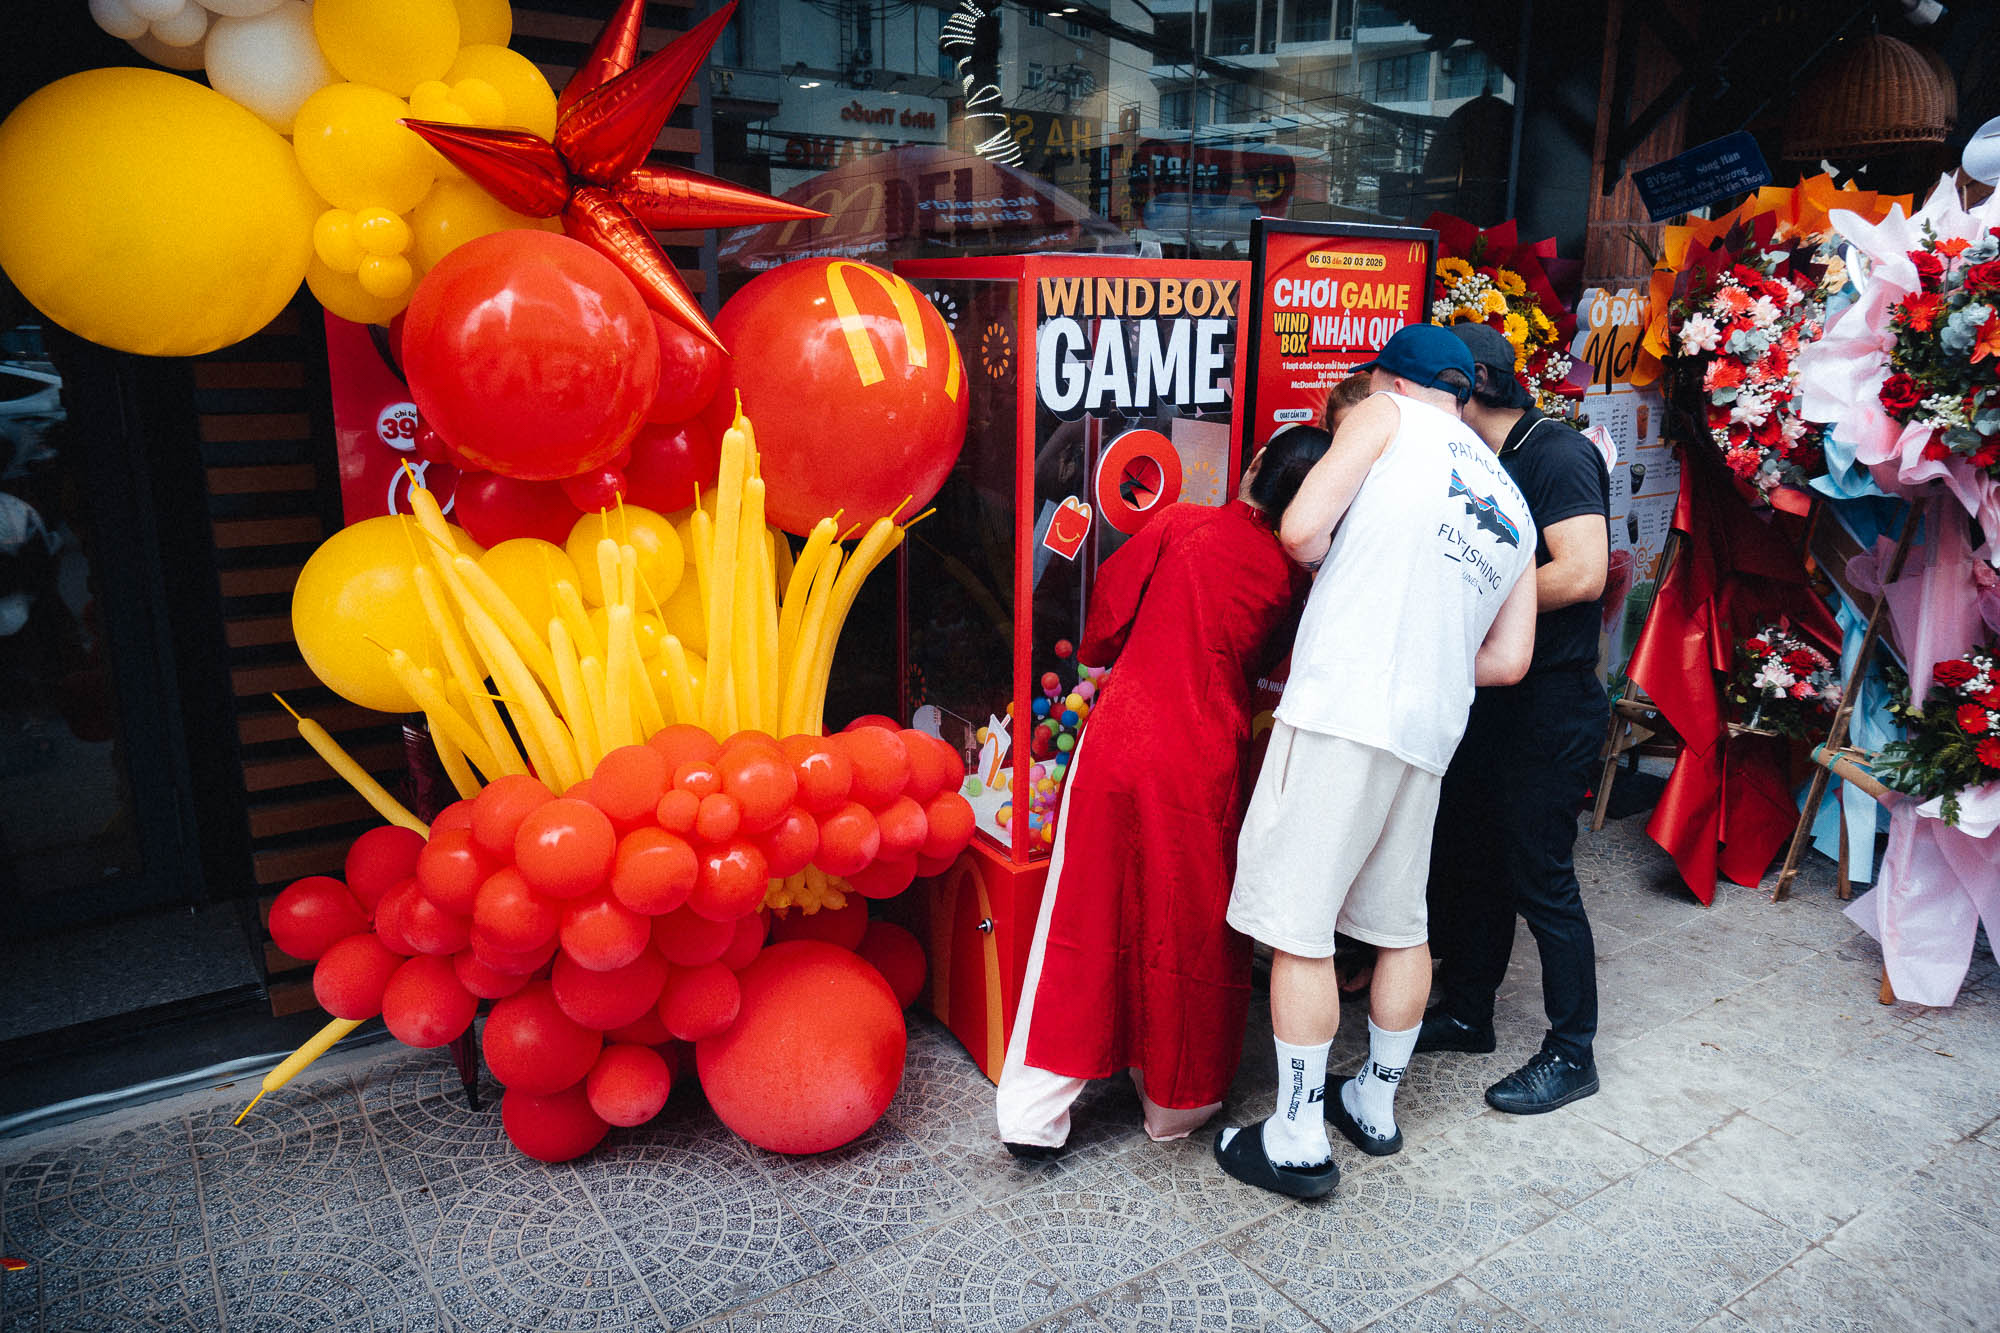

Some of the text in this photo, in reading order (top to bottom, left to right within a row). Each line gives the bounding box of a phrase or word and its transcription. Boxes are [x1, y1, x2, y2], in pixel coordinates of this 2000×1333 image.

[1273, 277, 1411, 311] CHƠI GAME
[1273, 312, 1309, 333] WIND
[1311, 308, 1366, 353] NHẬN
[1280, 333, 1308, 354] BOX
[1038, 317, 1229, 412] GAME
